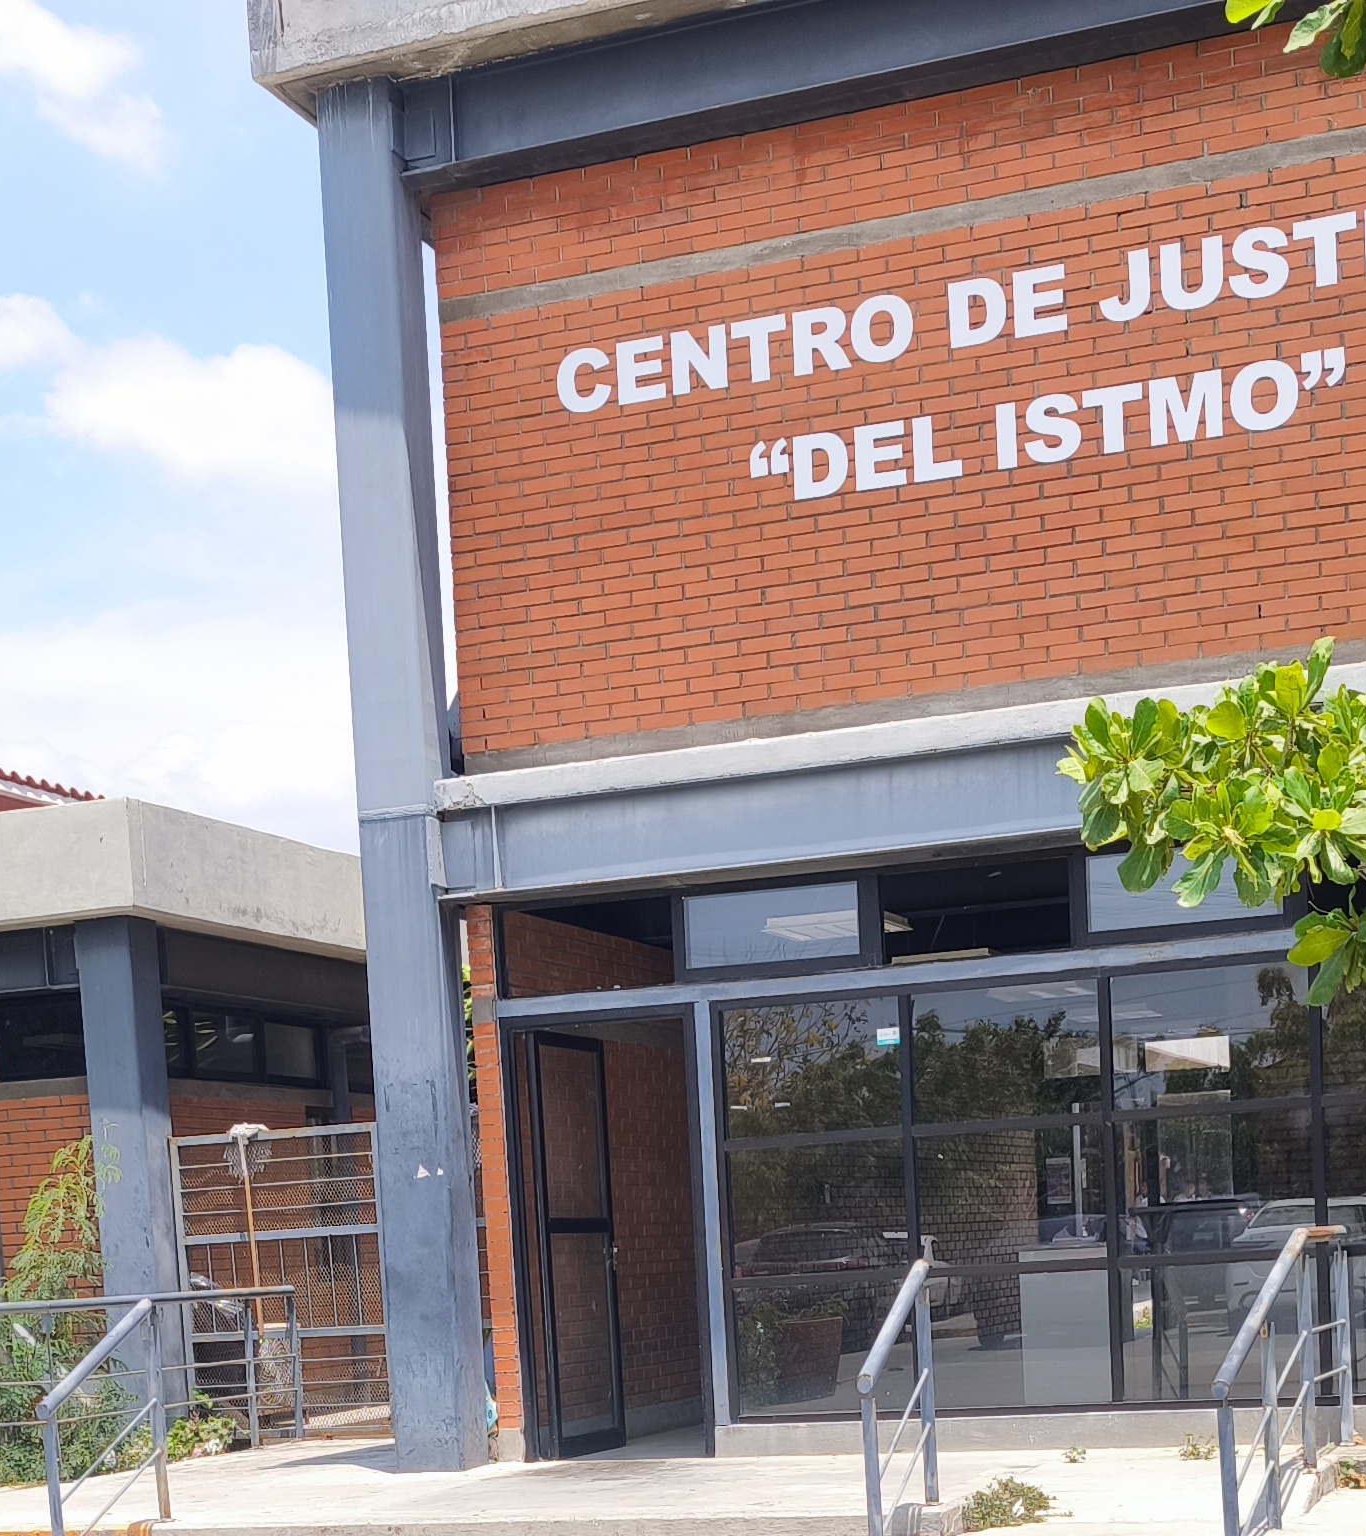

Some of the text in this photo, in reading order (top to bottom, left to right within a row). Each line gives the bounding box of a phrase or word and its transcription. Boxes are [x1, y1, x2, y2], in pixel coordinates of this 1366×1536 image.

[555, 306, 914, 413] CENTRO
[947, 263, 1068, 349] DE
[749, 346, 1346, 501] “DEL ISTMO”
